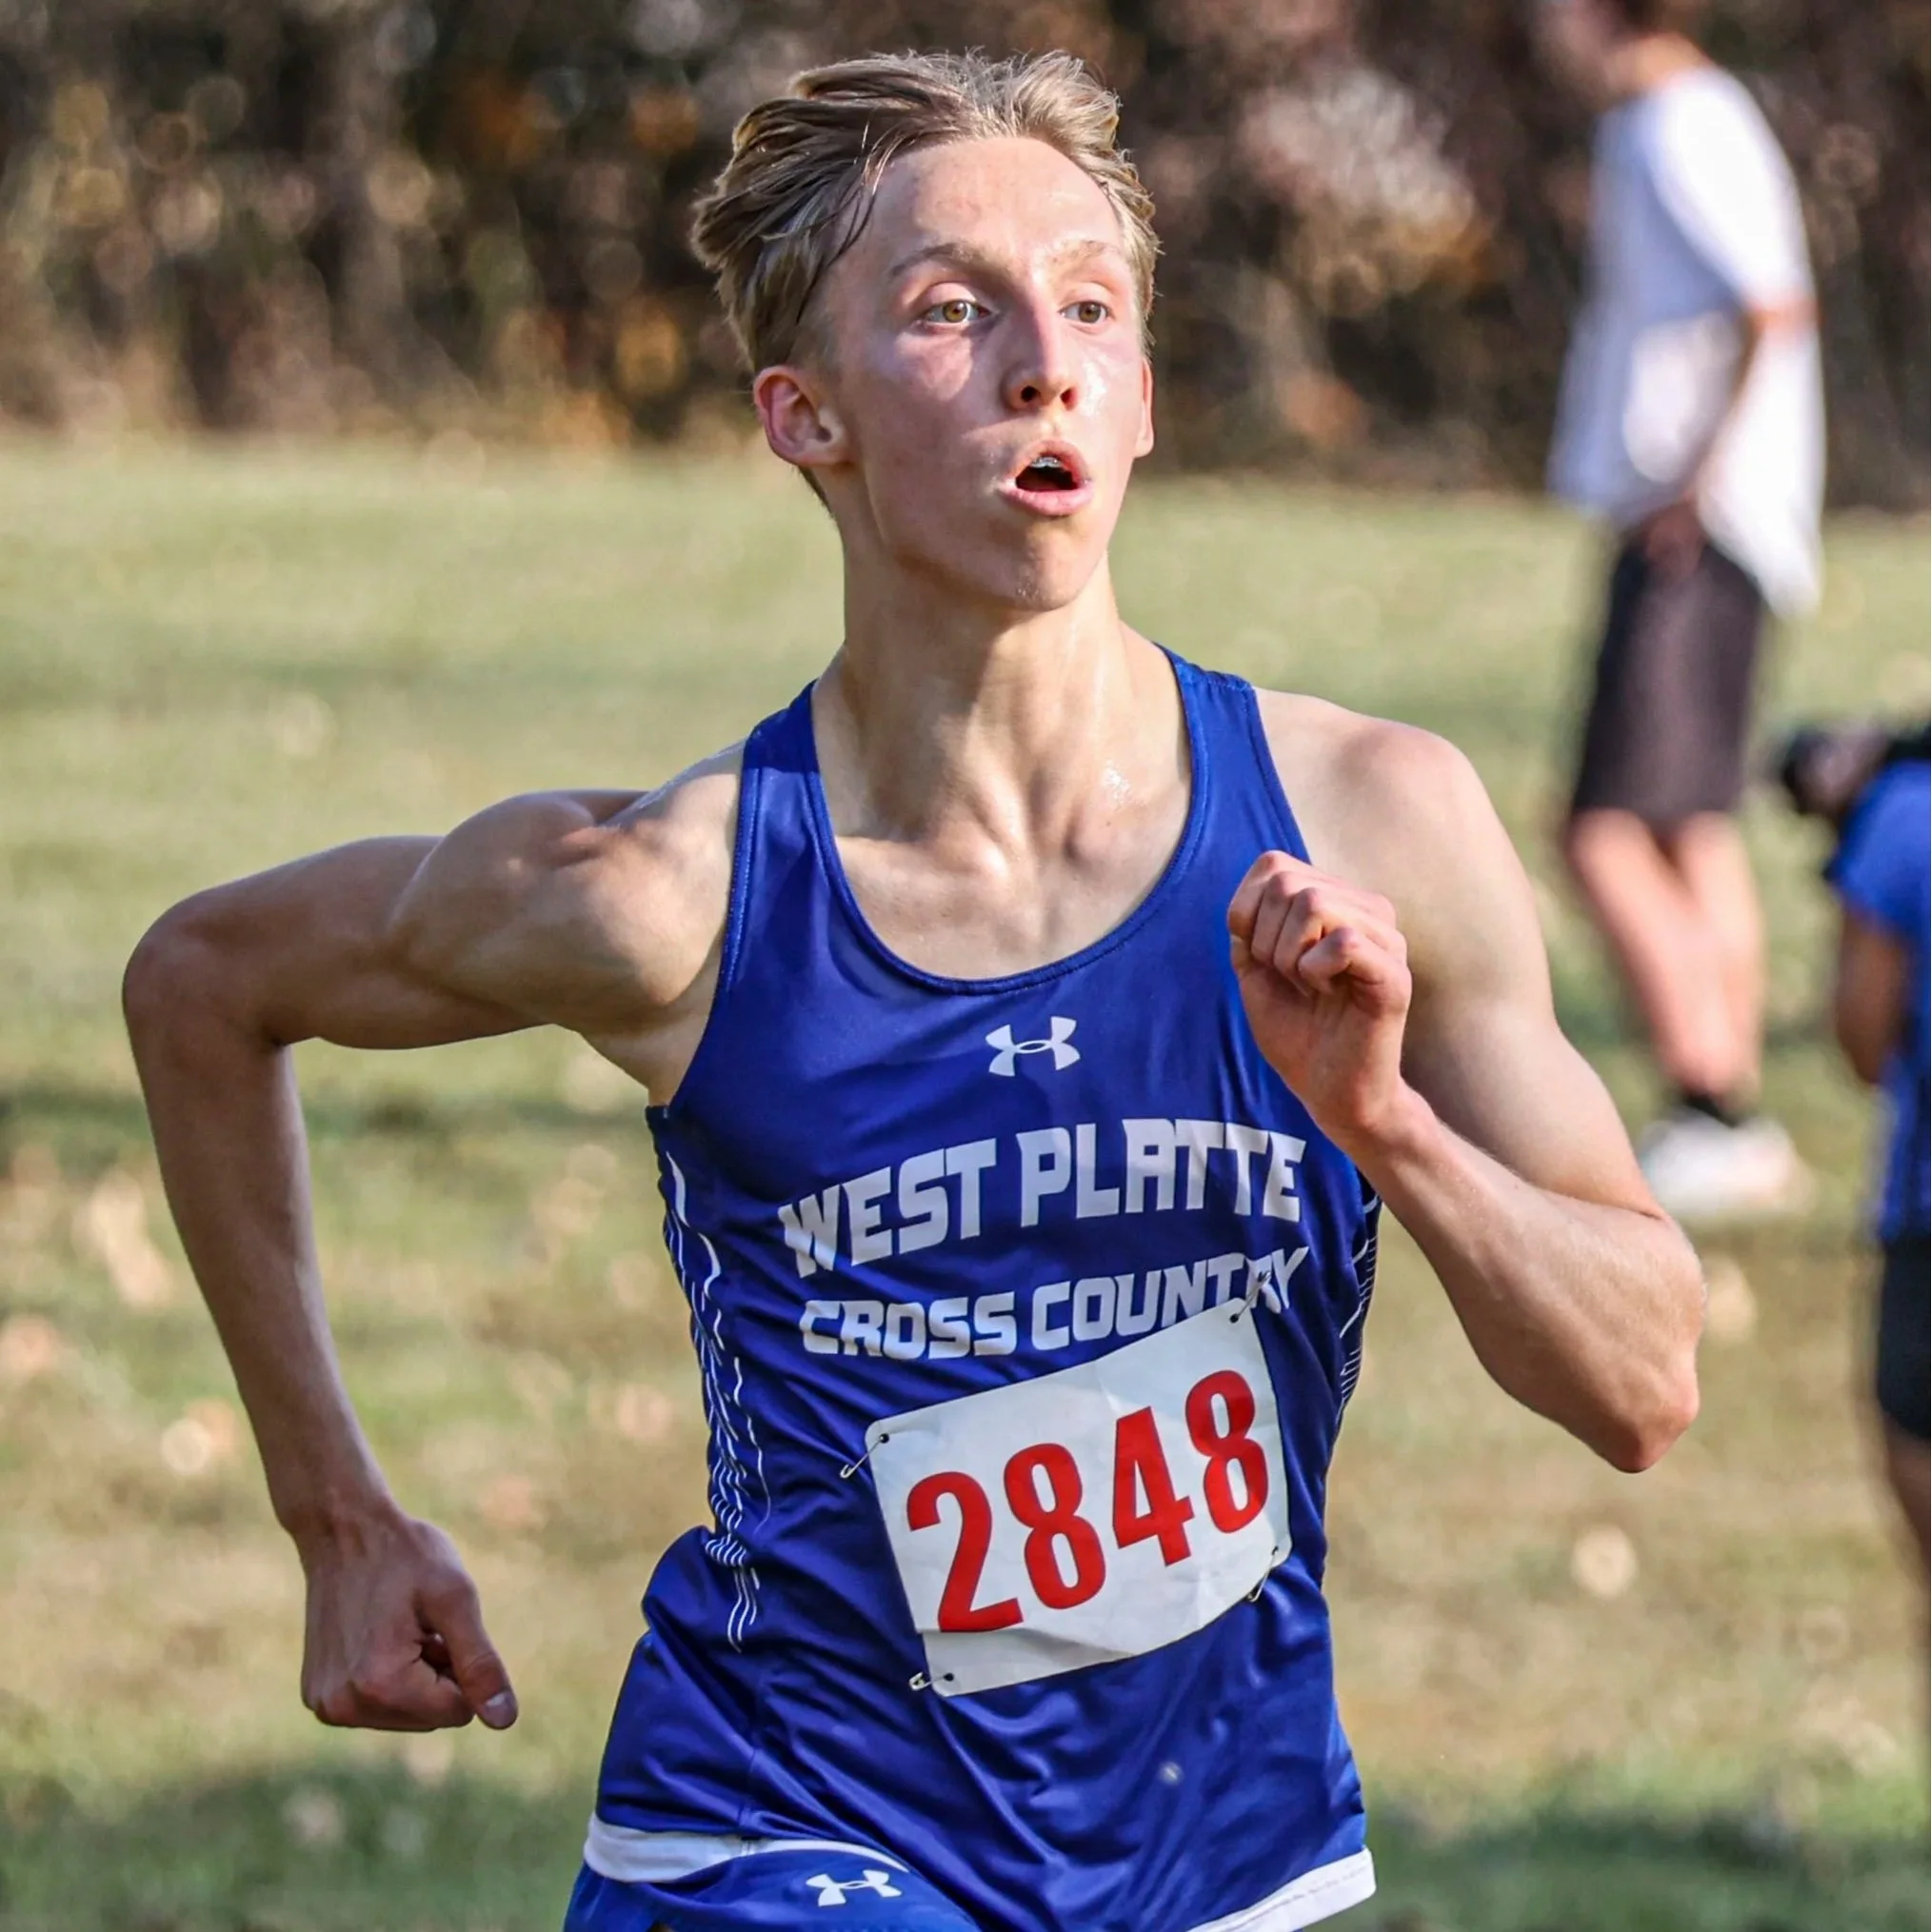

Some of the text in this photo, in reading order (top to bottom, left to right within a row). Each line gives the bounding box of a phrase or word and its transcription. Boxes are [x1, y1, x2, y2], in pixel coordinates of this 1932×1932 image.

[777, 1118, 1306, 1278] WEST PLATTE
[799, 1245, 1309, 1360] CROSS COUNTRY
[906, 1369, 1268, 1632] 2848
